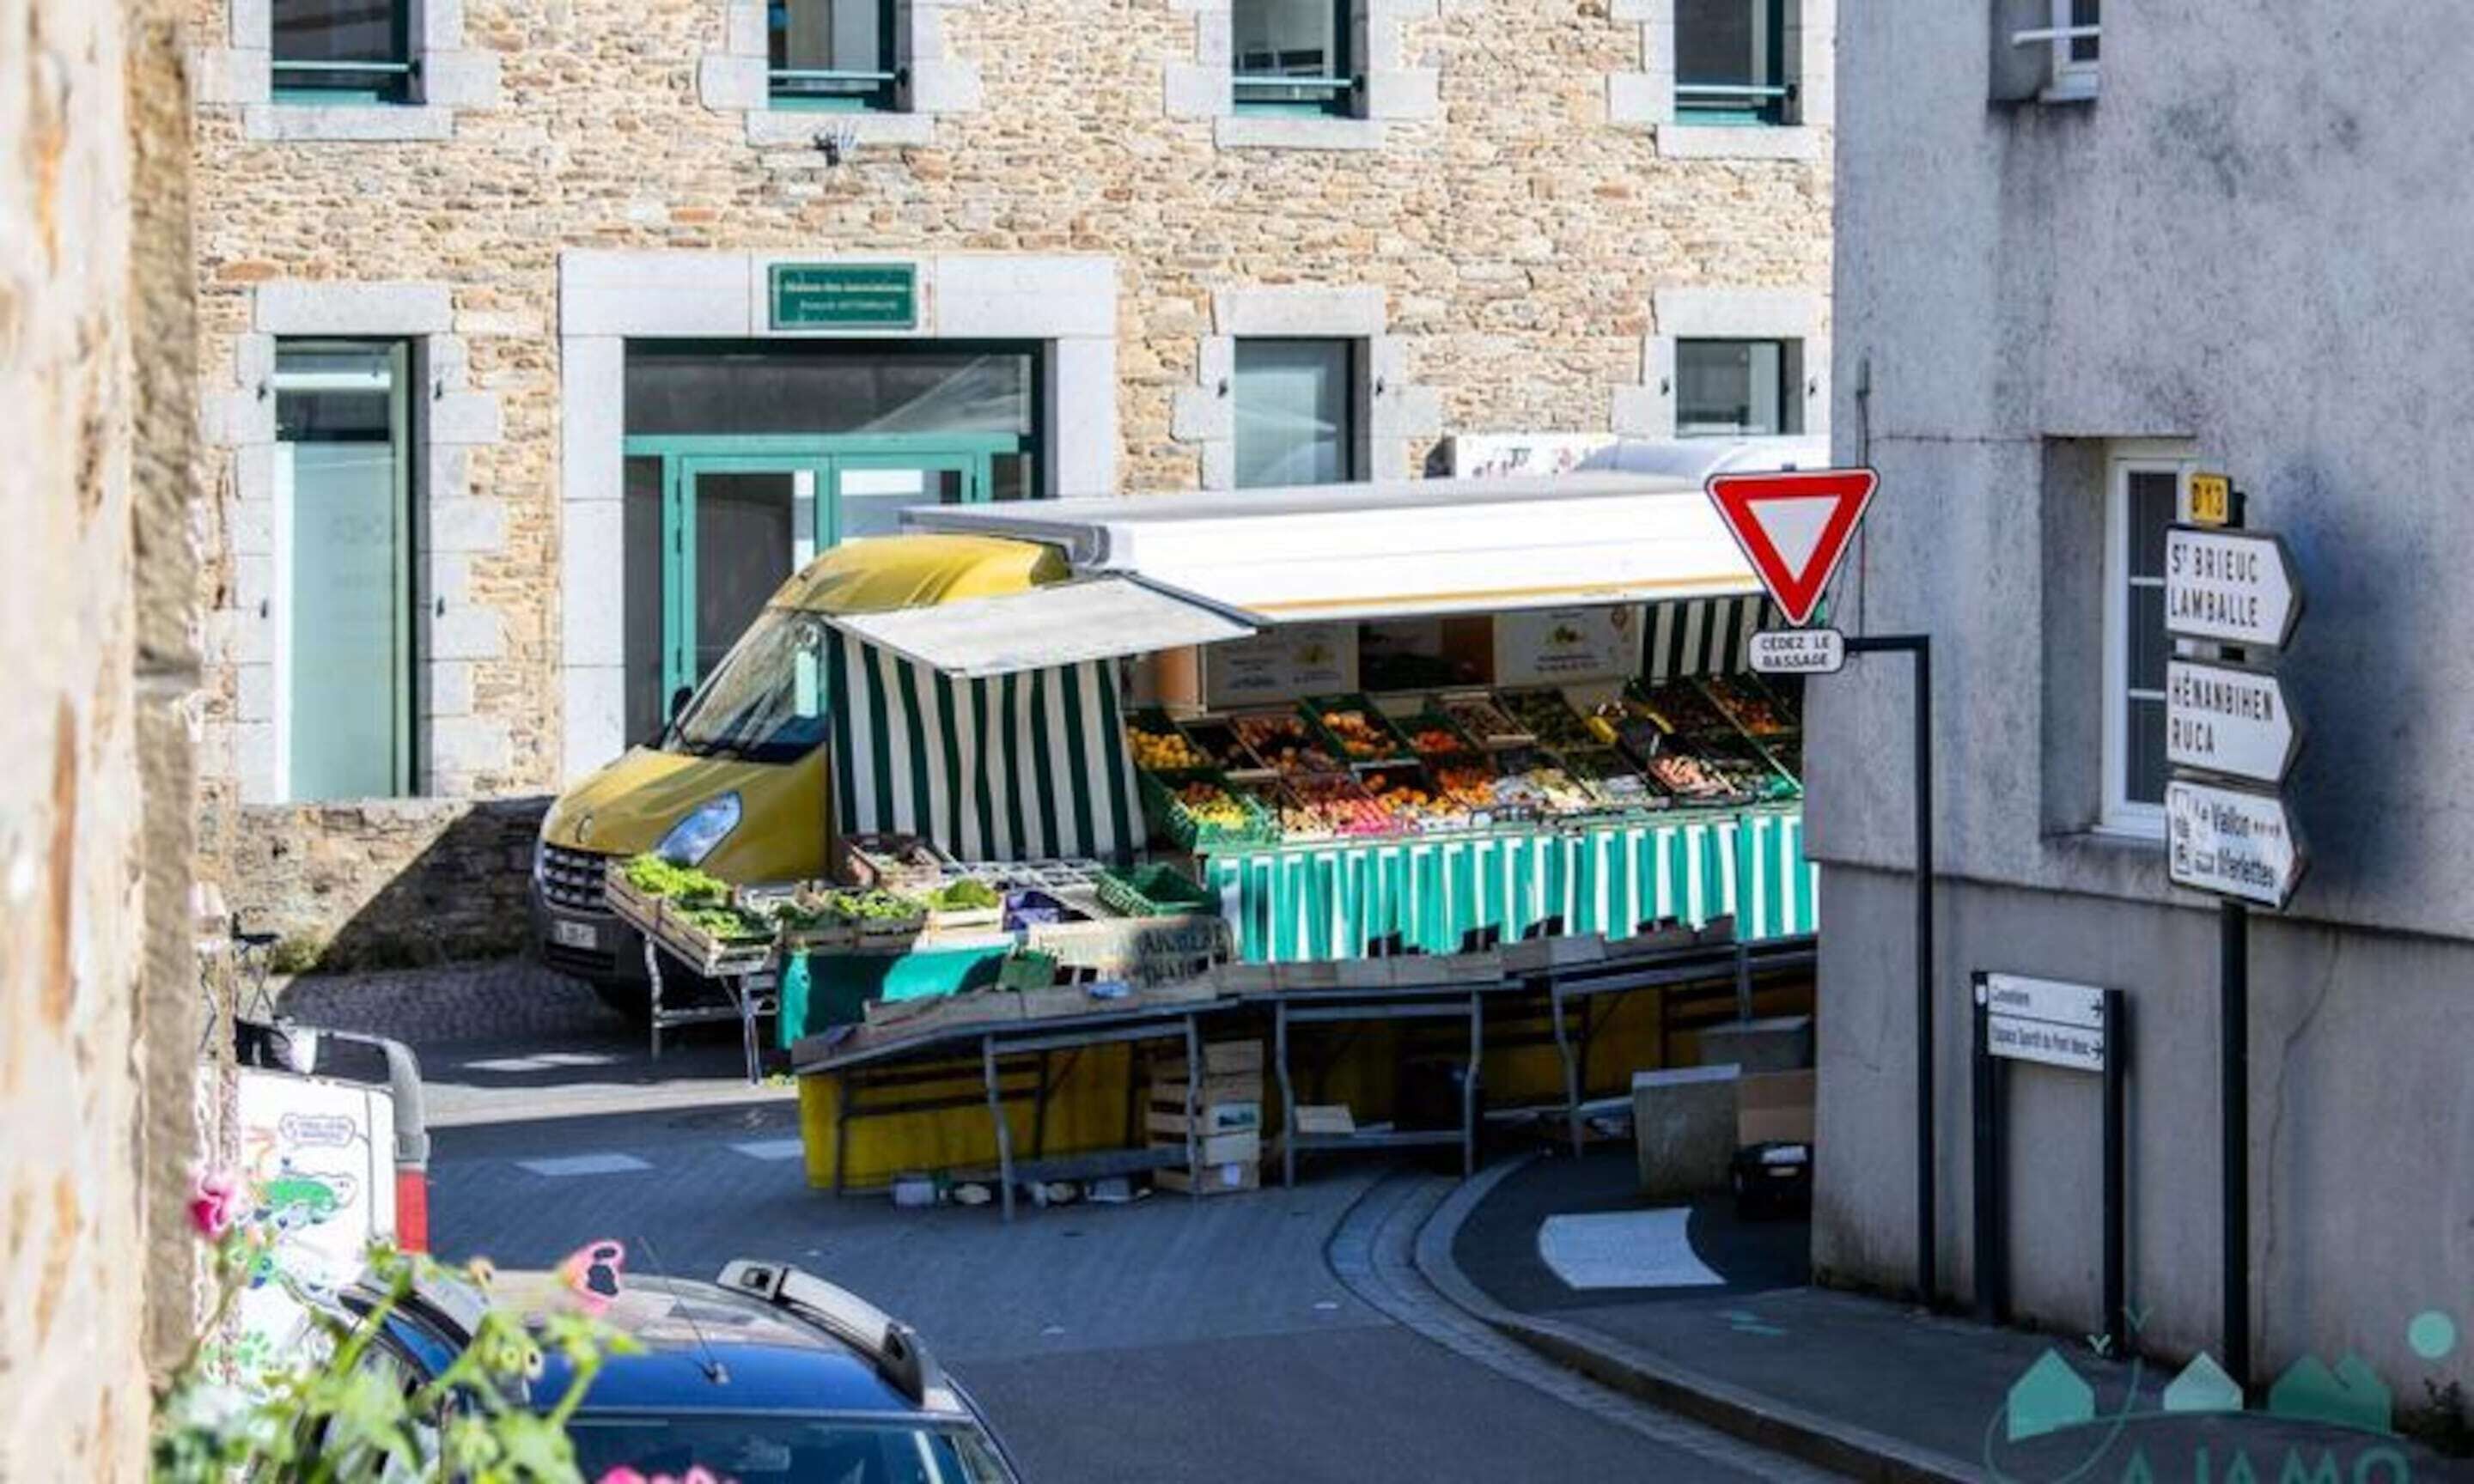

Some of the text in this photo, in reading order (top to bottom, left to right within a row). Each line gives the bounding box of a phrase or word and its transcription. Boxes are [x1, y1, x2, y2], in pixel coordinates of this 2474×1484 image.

[2193, 483, 2222, 516] D13
[2195, 547, 2258, 585] BRIEUC
[2171, 588, 2258, 628] LAMBALLE
[1814, 636, 1829, 648] LE
[2171, 671, 2273, 721] HÉNANBIHEN
[2172, 717, 2213, 753] RUCA
